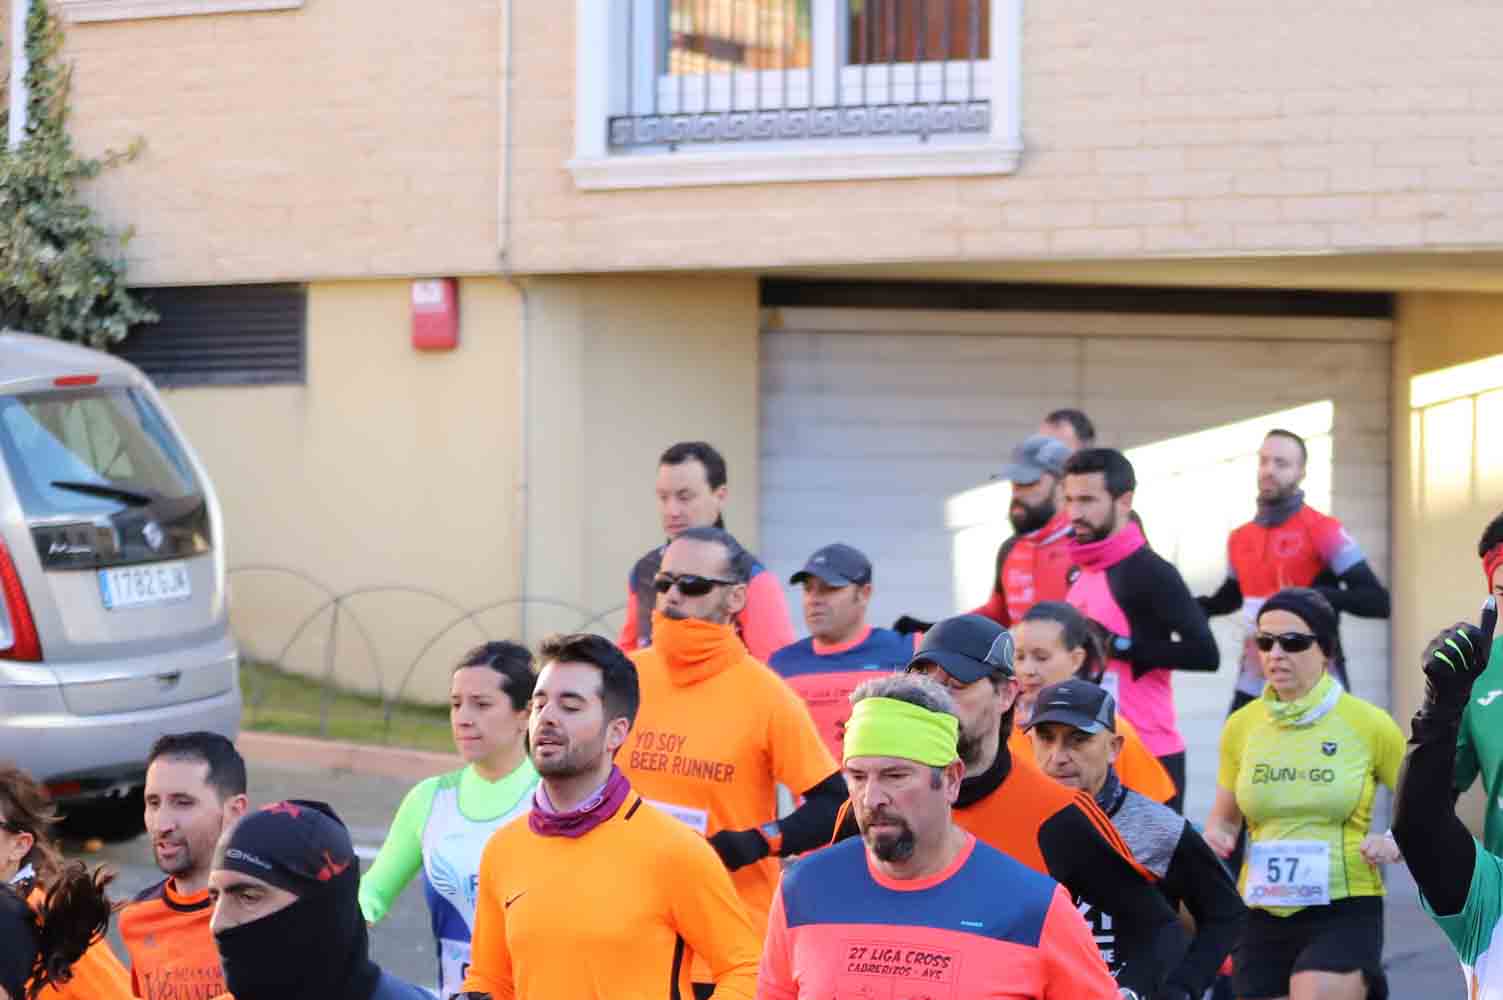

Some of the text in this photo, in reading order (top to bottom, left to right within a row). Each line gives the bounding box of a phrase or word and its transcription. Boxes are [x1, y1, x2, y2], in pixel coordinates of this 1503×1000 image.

[636, 731, 687, 753] YO SOY
[629, 751, 736, 783] BEER RUNNER
[1266, 857, 1299, 884] 57
[849, 947, 952, 969] 27 LIGA CROSS
